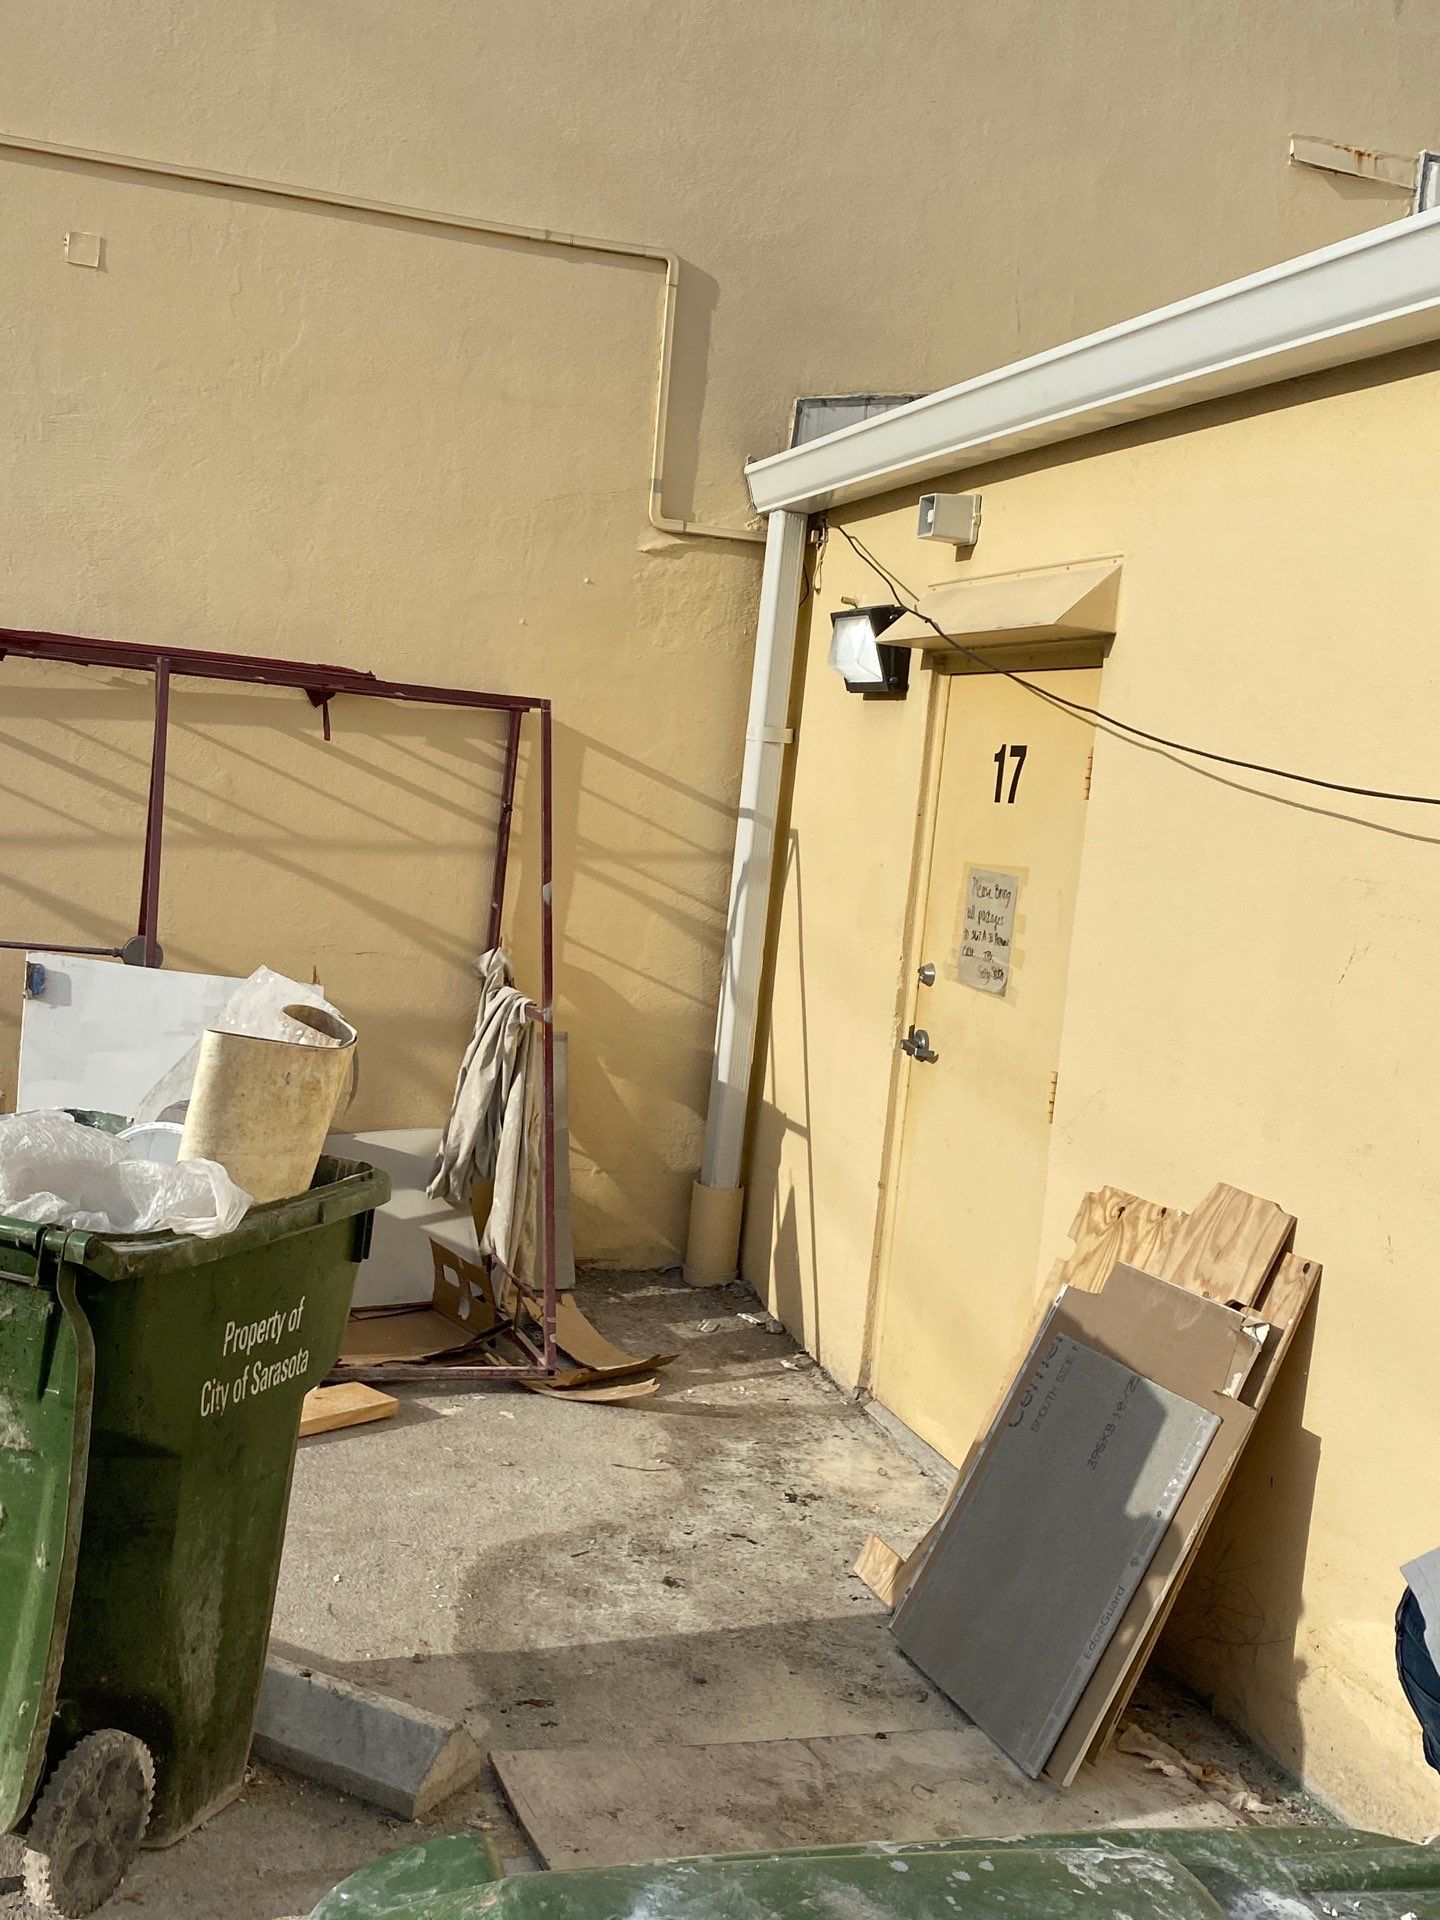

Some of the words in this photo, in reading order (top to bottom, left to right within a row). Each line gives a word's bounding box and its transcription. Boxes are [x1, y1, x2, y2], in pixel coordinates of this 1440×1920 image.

[993, 744, 1028, 804] 17
[222, 1310, 287, 1357] Property
[287, 1295, 306, 1332] of
[200, 1378, 230, 1417] City
[232, 1364, 250, 1403] of
[250, 1347, 309, 1395] Sarasota
[1083, 1585, 1126, 1660] EdgeGuard
